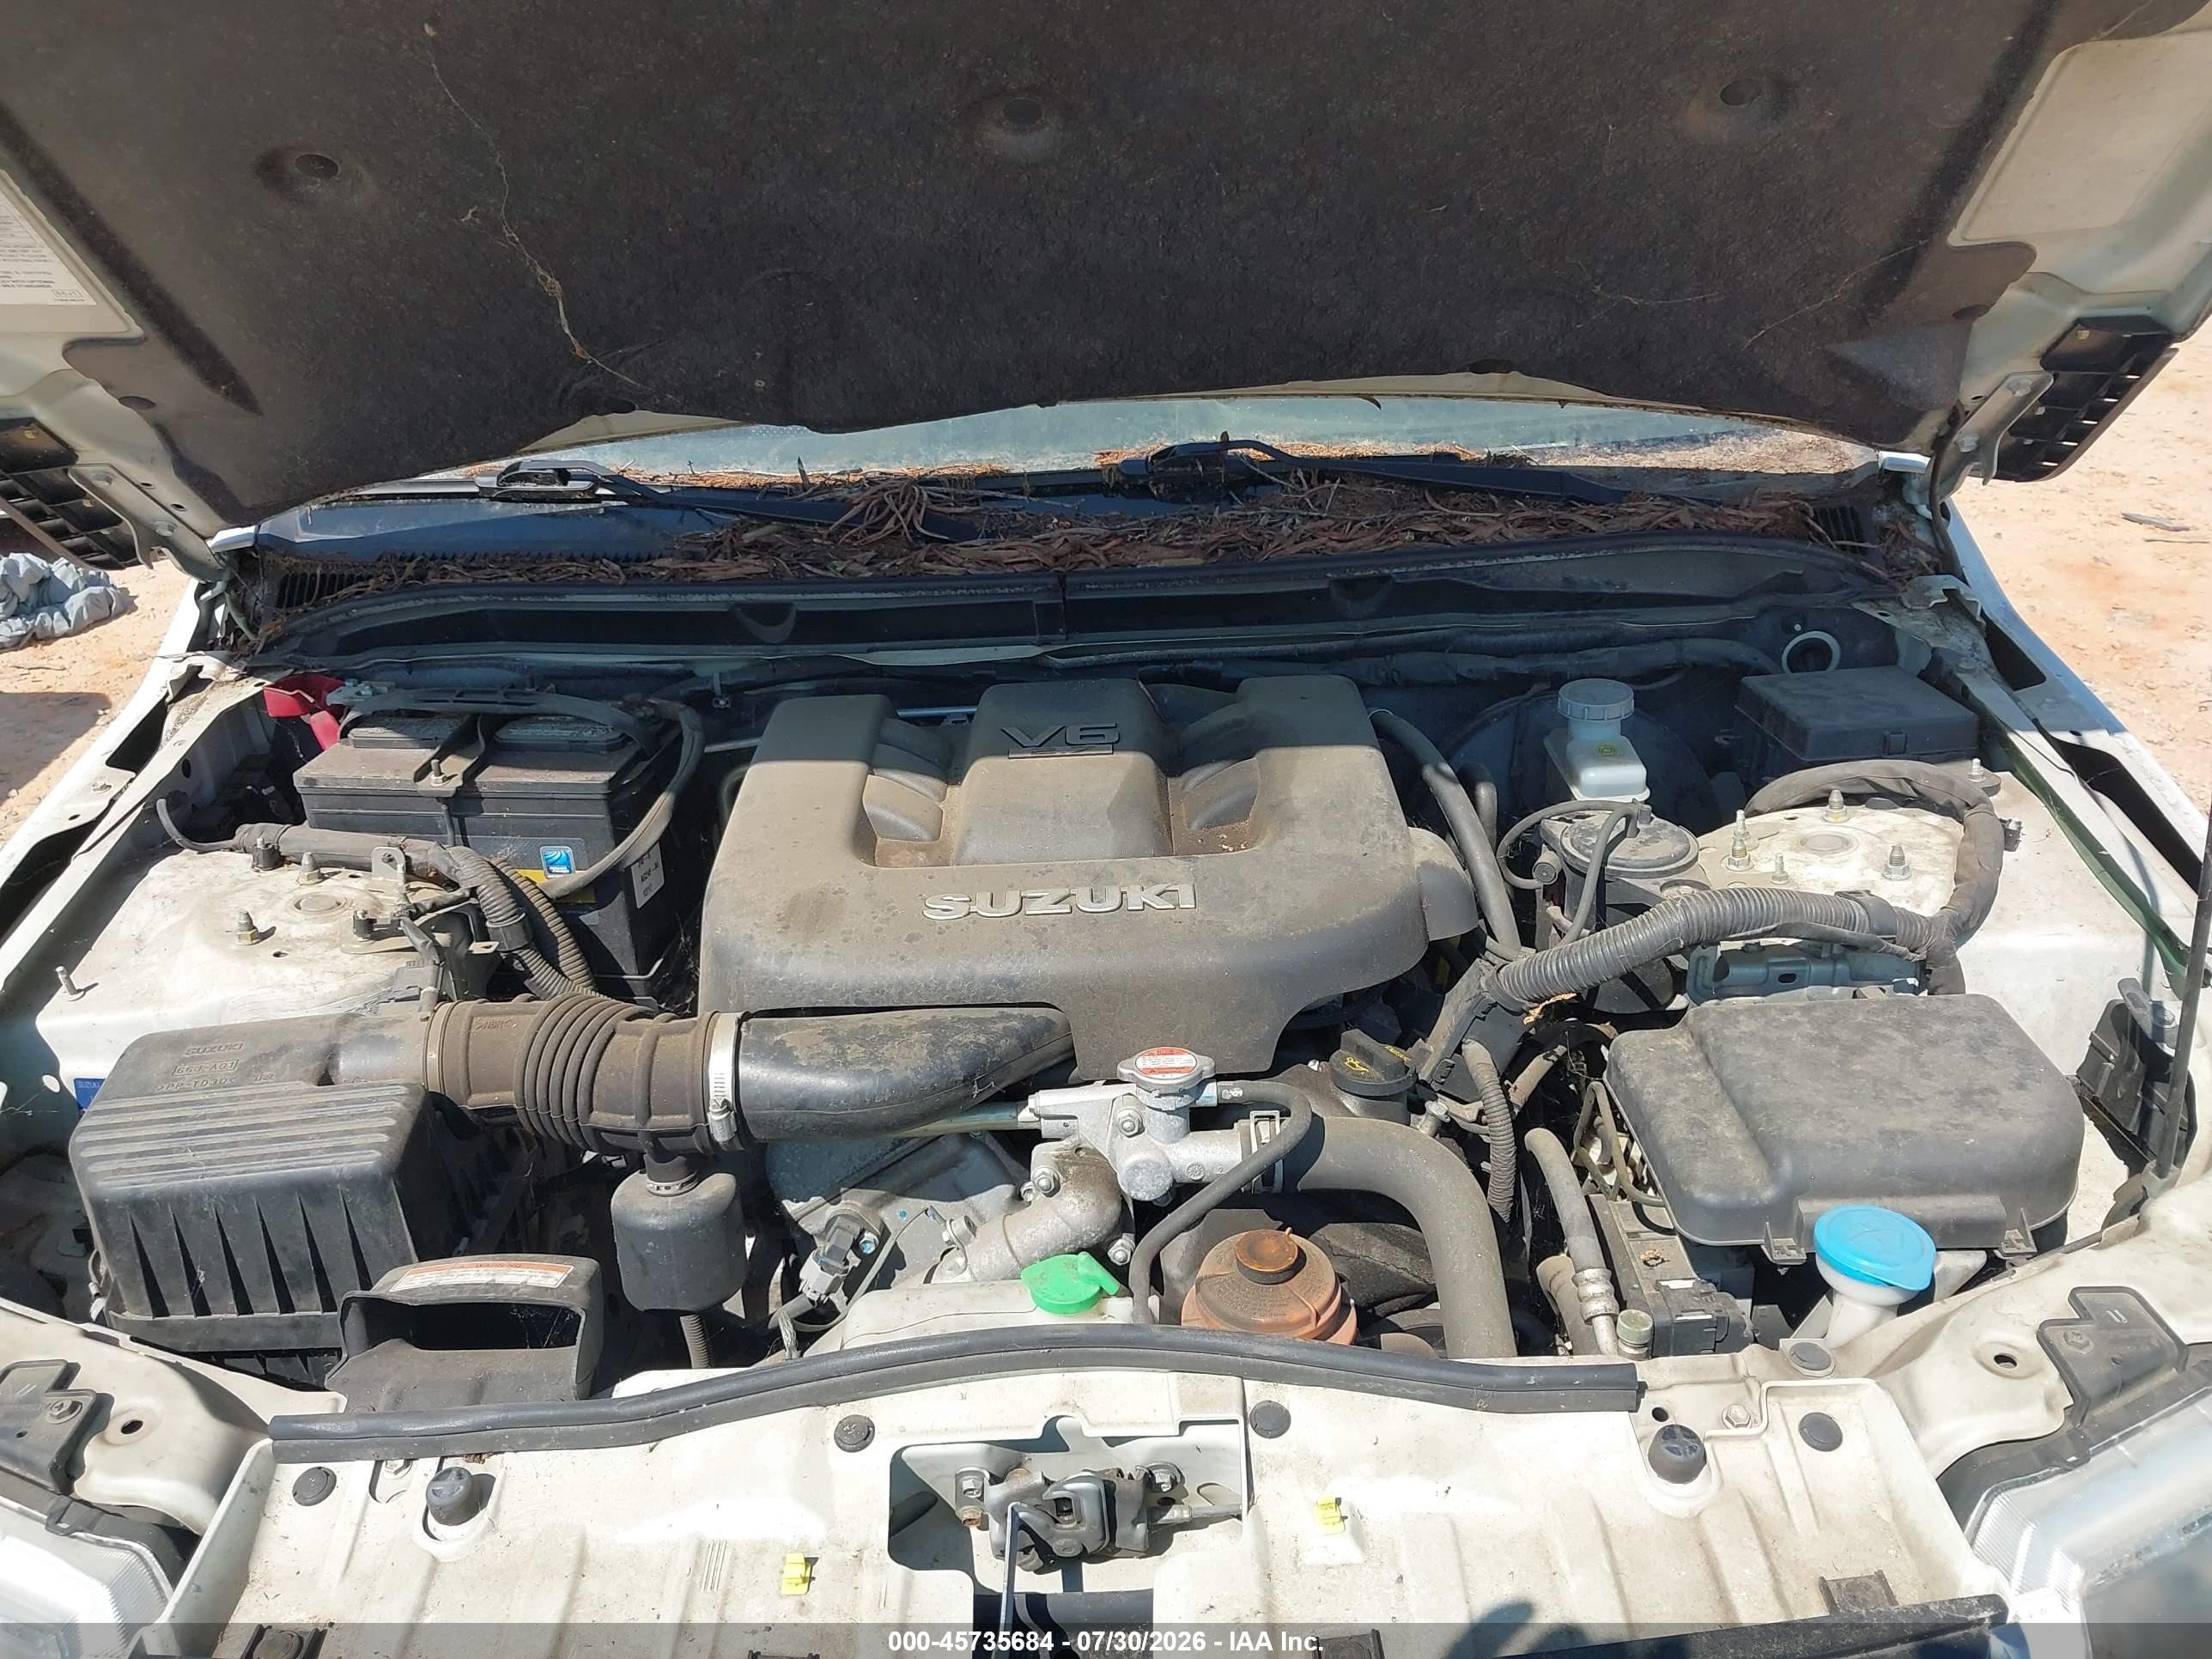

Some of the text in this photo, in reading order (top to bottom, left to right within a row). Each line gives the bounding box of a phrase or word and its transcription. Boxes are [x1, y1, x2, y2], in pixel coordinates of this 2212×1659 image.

[1000, 723, 1121, 748] V6
[923, 884, 1197, 921] SUZUKI
[184, 1042, 246, 1057] SUZUKI
